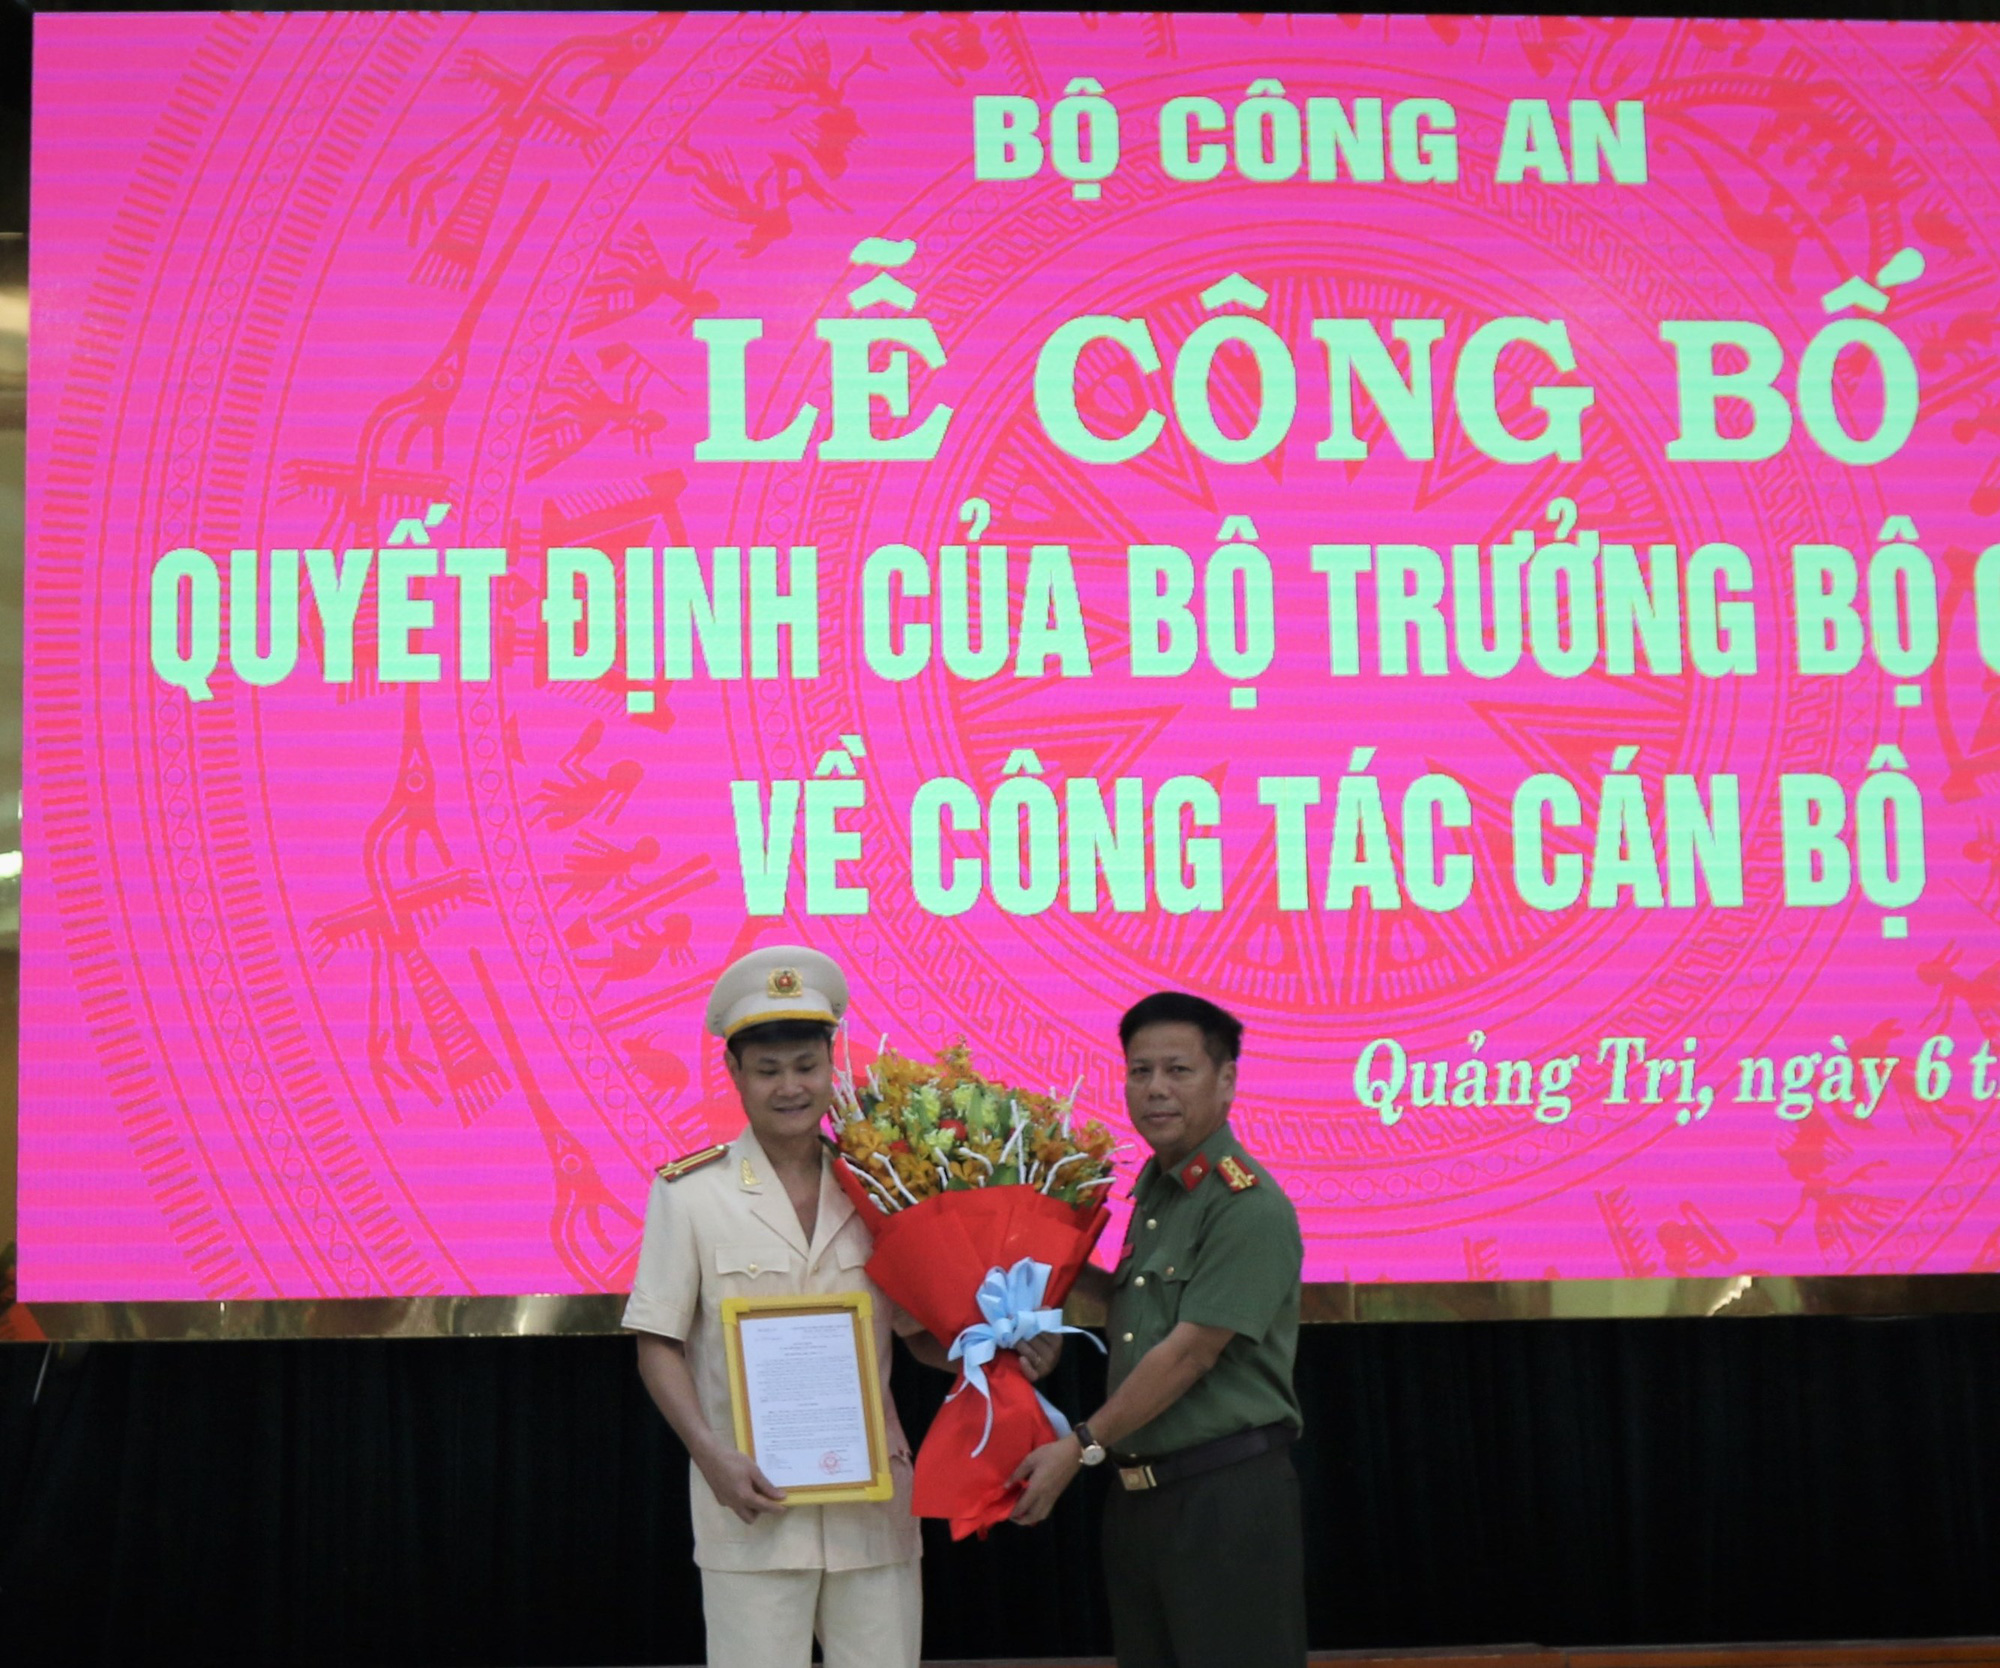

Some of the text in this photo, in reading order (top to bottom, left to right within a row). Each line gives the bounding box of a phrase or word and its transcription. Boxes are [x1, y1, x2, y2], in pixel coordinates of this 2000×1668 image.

[975, 78, 1648, 200] BỘ CÔNG AN
[693, 237, 1925, 465] LỄ CÔNG BỐ
[150, 503, 508, 702] QUYẾT
[541, 546, 820, 713] ĐỊNH
[862, 497, 1092, 682] CỦA
[1127, 515, 1276, 709] BỘ
[1310, 497, 1758, 679] TRƯỞNG
[1792, 515, 1939, 707] BỘ
[730, 734, 1926, 939] VỀ CÔNG TÁC CÁN BỘ
[1353, 1030, 1581, 1126] Quảng
[1598, 1036, 1714, 1126] Trị,
[1735, 1035, 1899, 1121] ngày
[1915, 1035, 1954, 1101] 6
